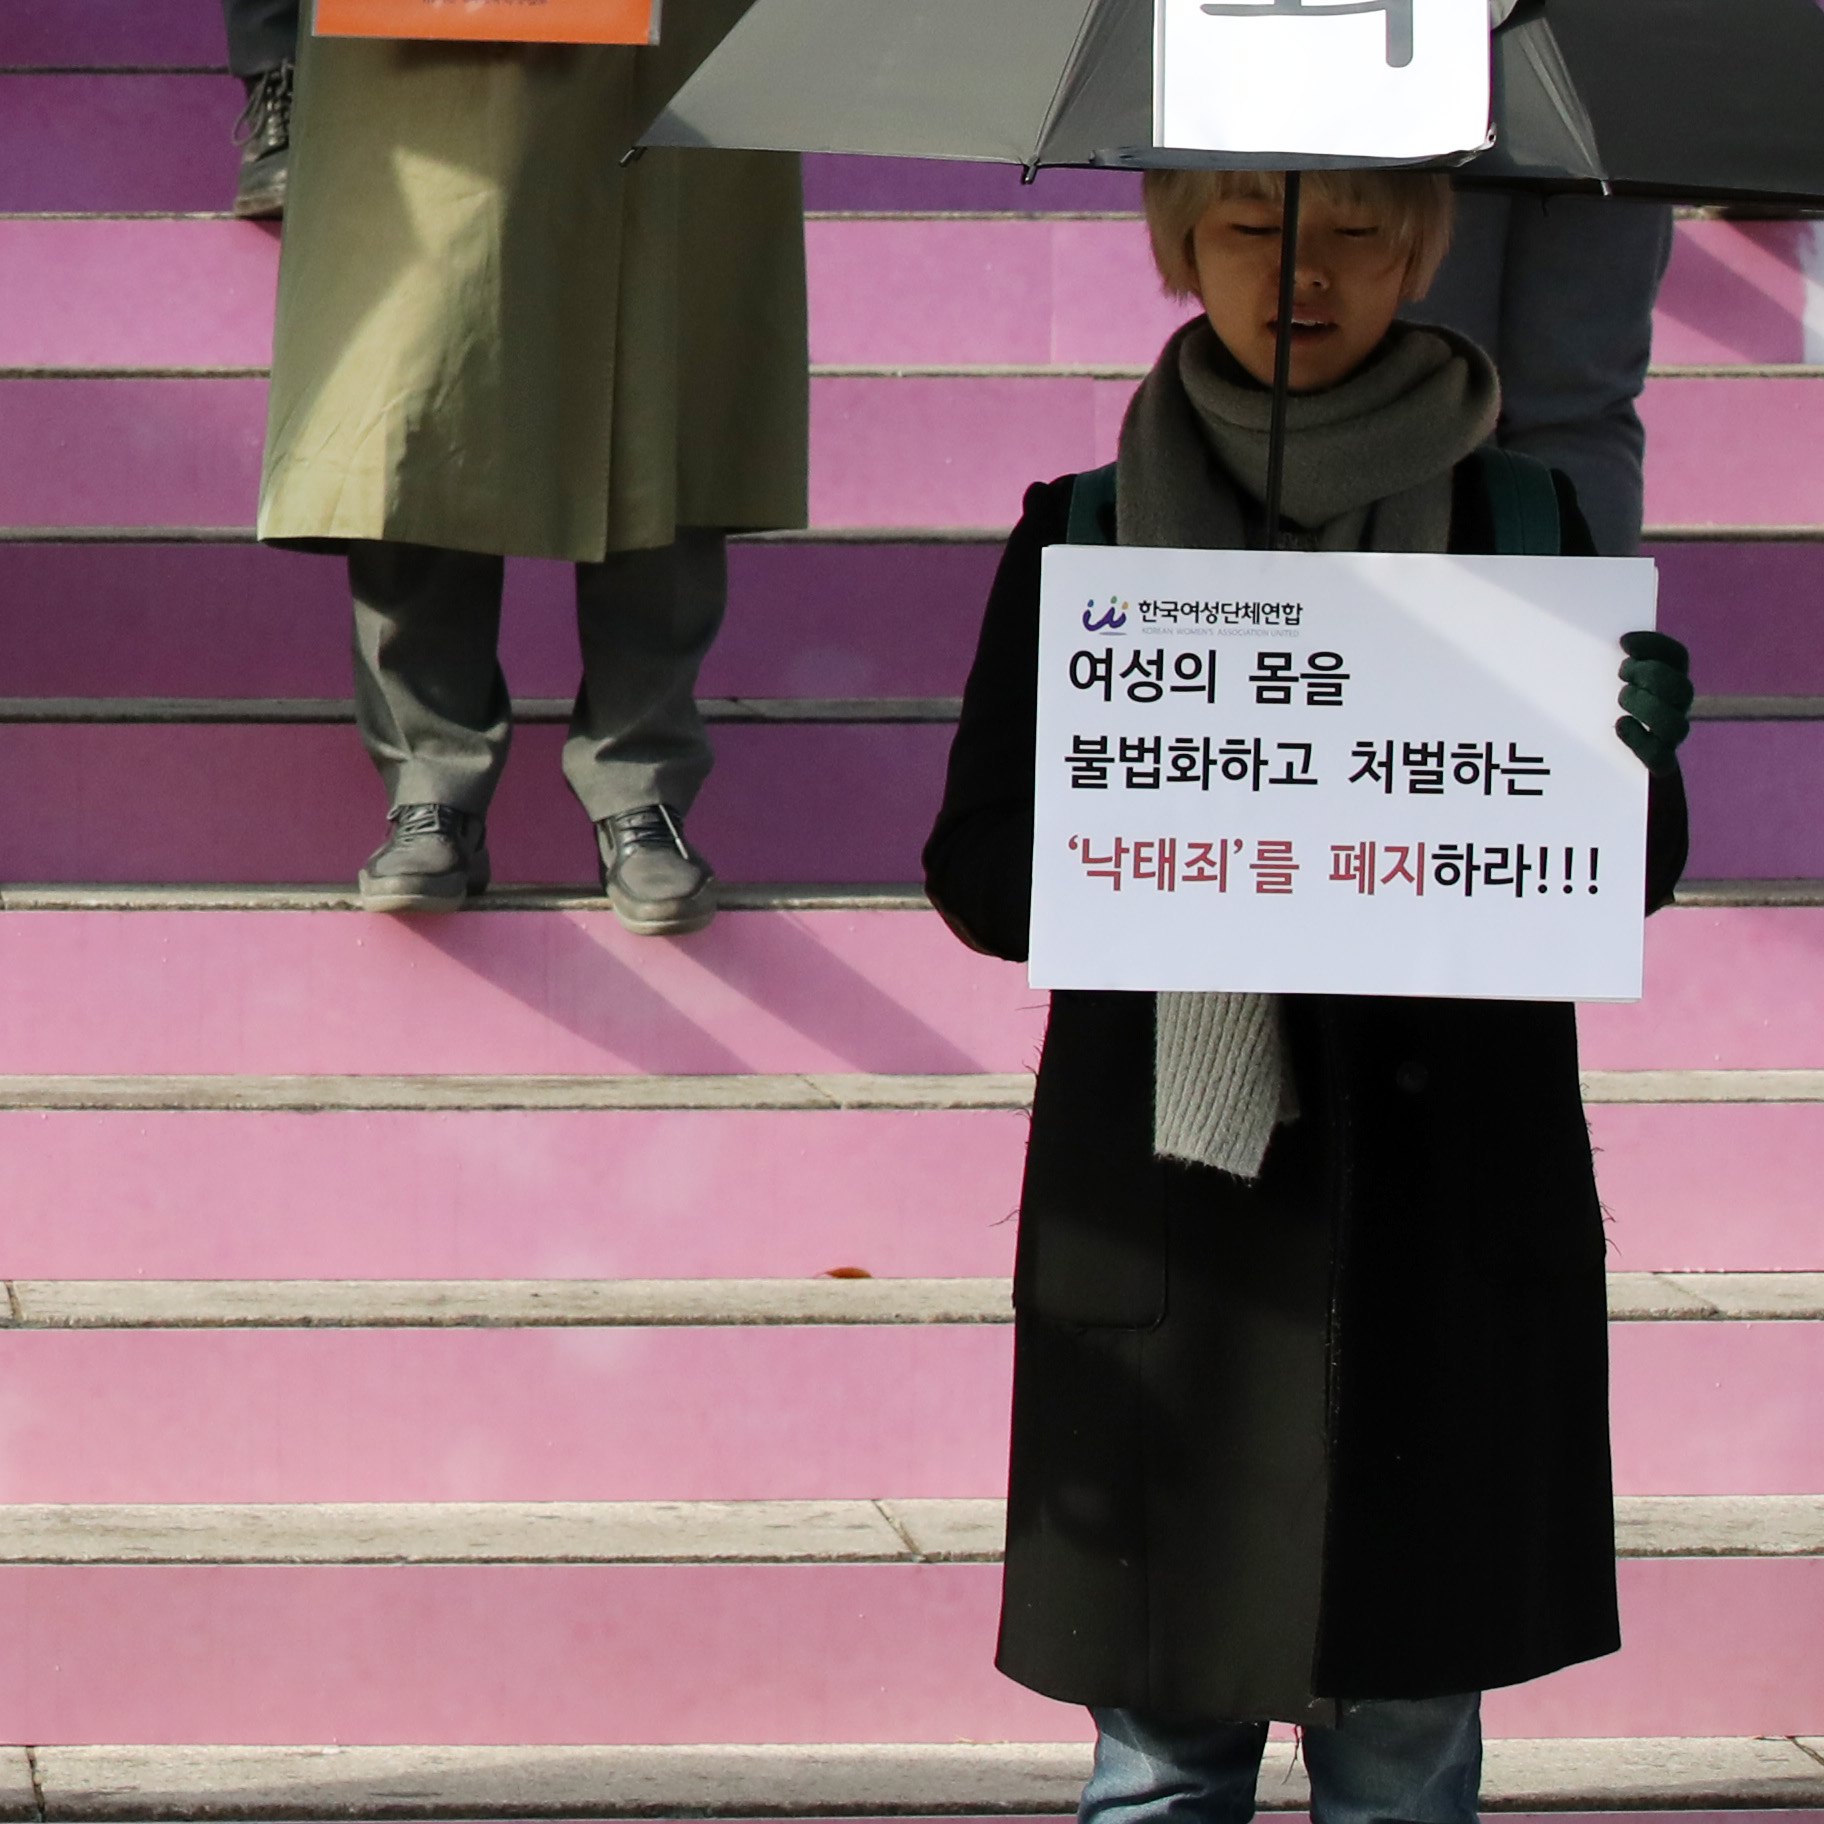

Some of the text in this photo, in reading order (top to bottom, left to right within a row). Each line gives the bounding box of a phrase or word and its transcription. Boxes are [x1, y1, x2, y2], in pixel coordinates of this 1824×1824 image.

[1138, 601, 1303, 625] 한국여성단체연합
[1069, 647, 1351, 707] 여성의 몸을
[1064, 735, 1551, 797] 불법화하고 처벌하는
[1329, 841, 1600, 898] 폐지하라!!!
